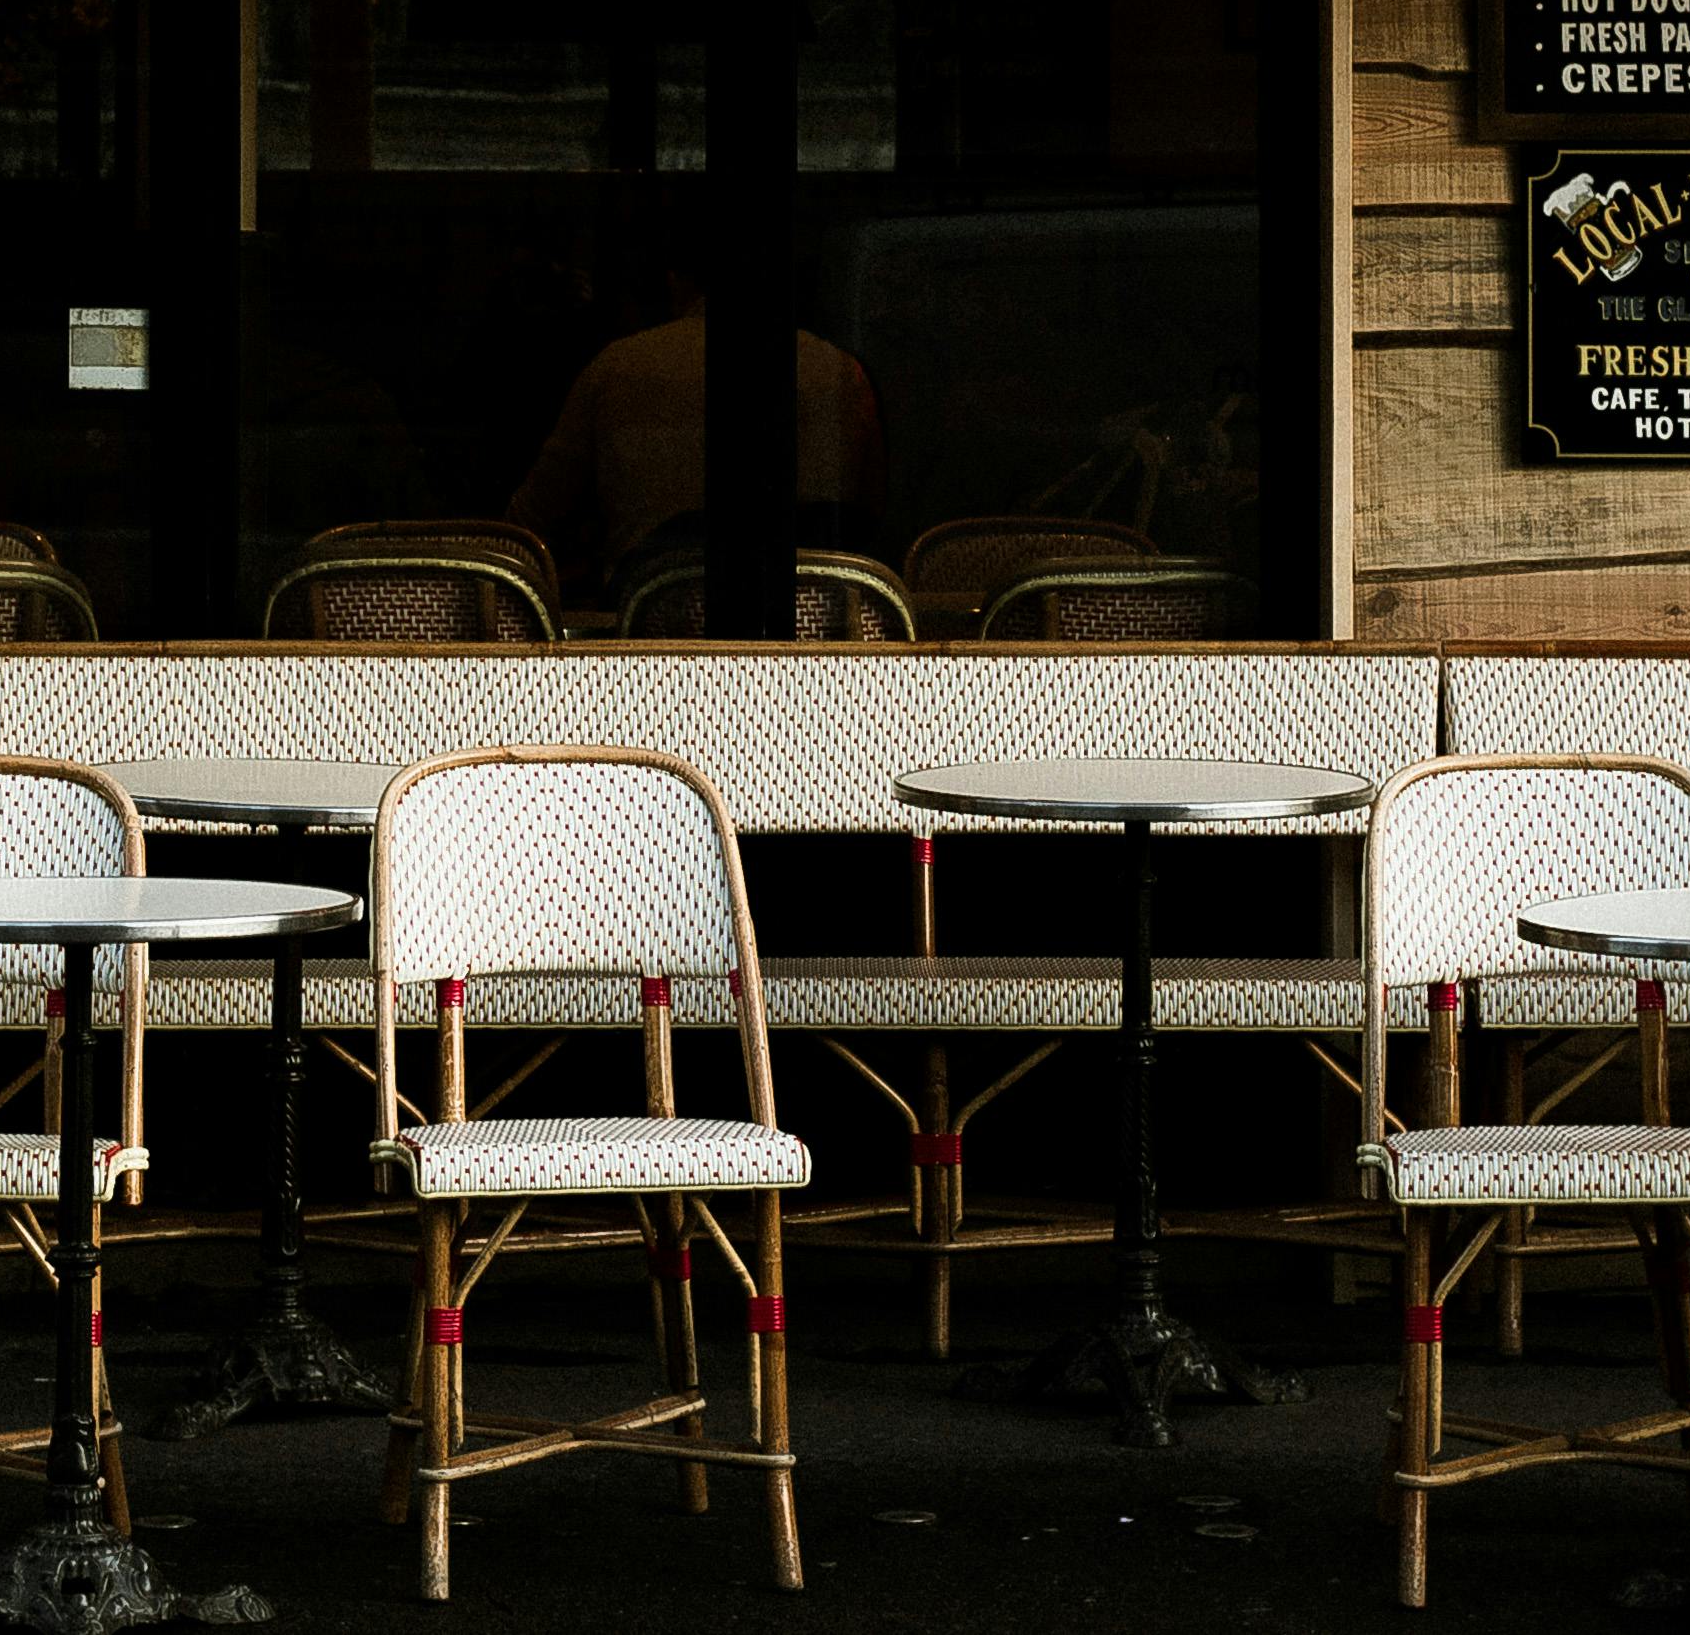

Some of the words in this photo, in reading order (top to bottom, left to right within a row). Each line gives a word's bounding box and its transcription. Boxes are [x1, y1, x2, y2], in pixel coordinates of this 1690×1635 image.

[1561, 21, 1647, 54] FRESH
[1597, 297, 1644, 321] THE
[1591, 386, 1669, 412] CAFE,
